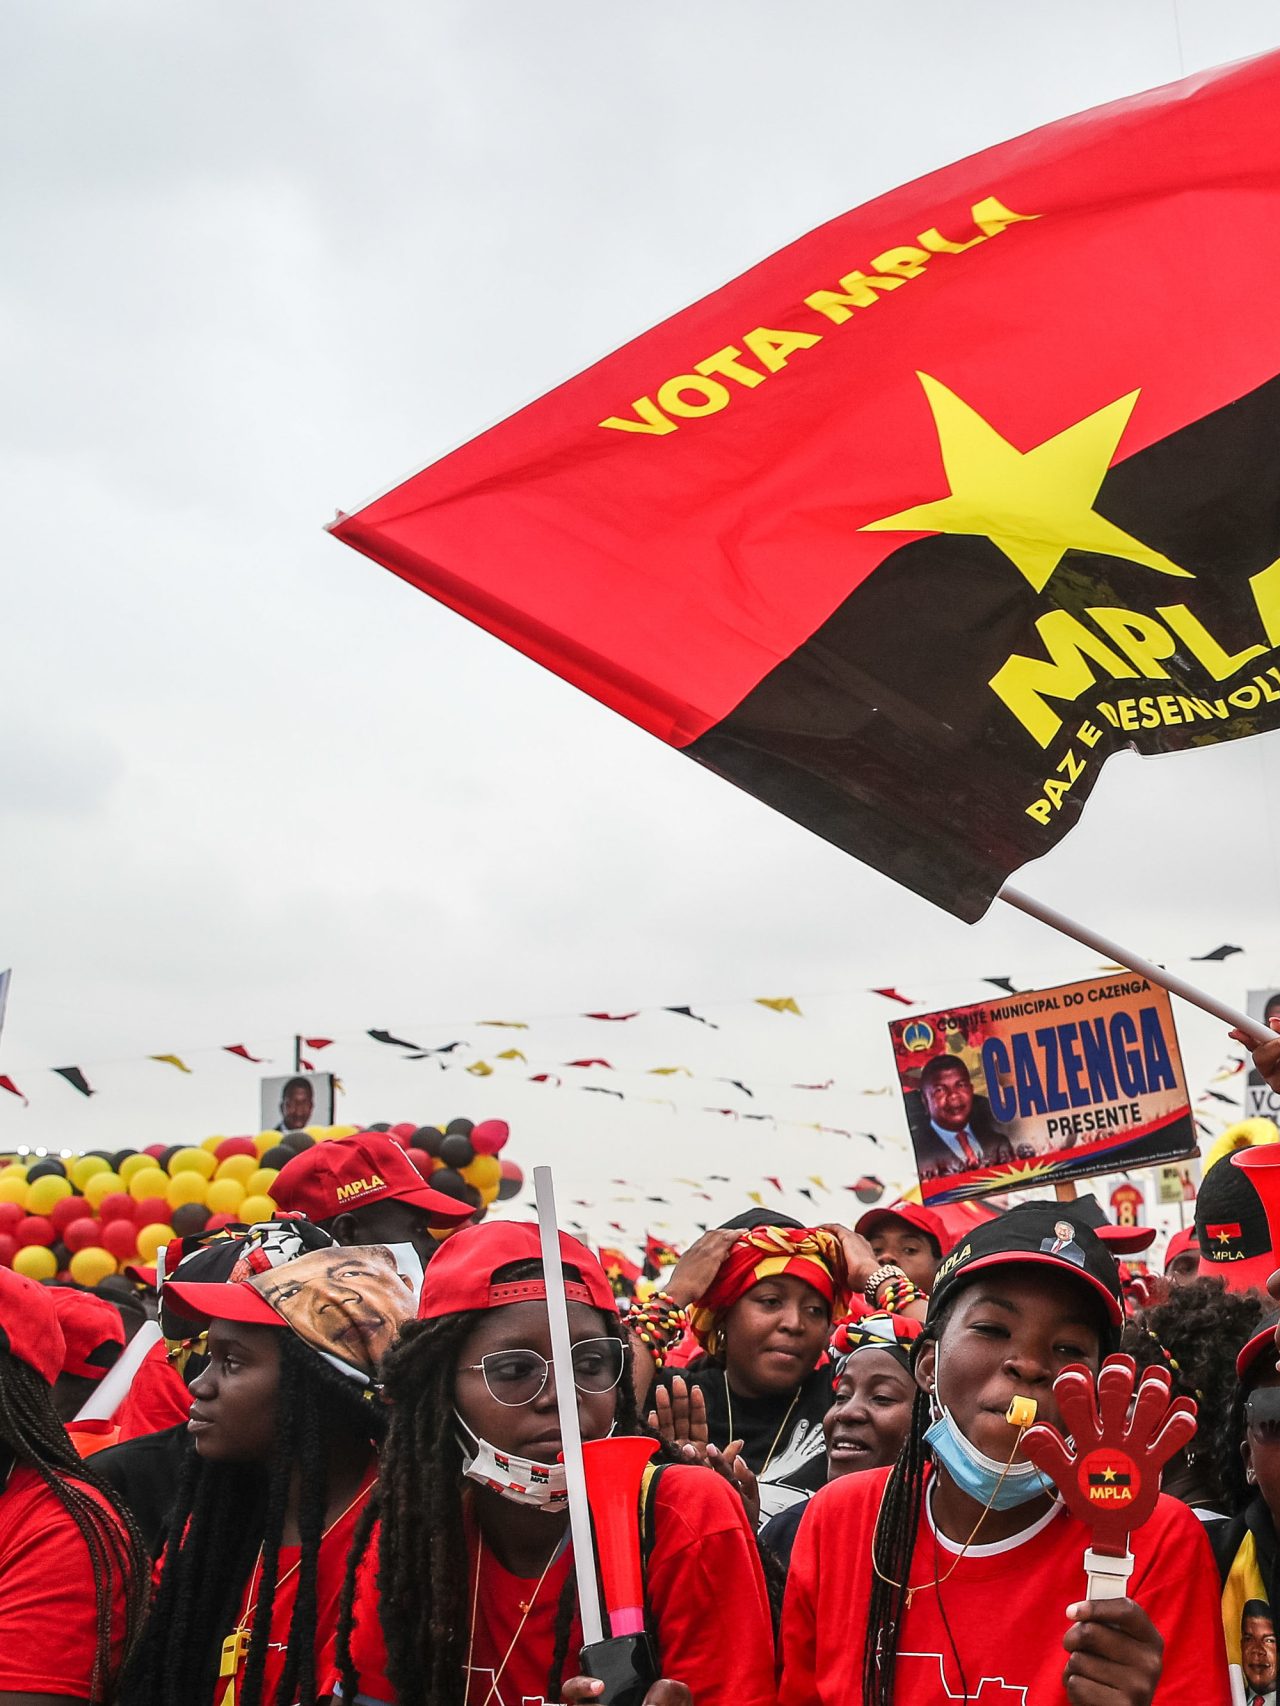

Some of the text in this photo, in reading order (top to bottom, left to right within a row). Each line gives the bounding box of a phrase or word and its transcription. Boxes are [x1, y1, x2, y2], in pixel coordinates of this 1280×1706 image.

[598, 196, 1045, 435] VOTA MPLA
[1025, 748, 1087, 825] PAZ
[1076, 719, 1104, 748] E
[990, 998, 1061, 1023] MUNICIPAL
[1064, 992, 1084, 1008] DO
[1087, 978, 1151, 1002] CAZENGA
[982, 1006, 1177, 1123] CAZENGA
[1047, 1102, 1142, 1138] PRESENTE
[336, 1175, 385, 1200] MPLA
[932, 1243, 972, 1290] MPLA
[1212, 1250, 1245, 1260] MPLA
[1089, 1486, 1132, 1499] MPLA
